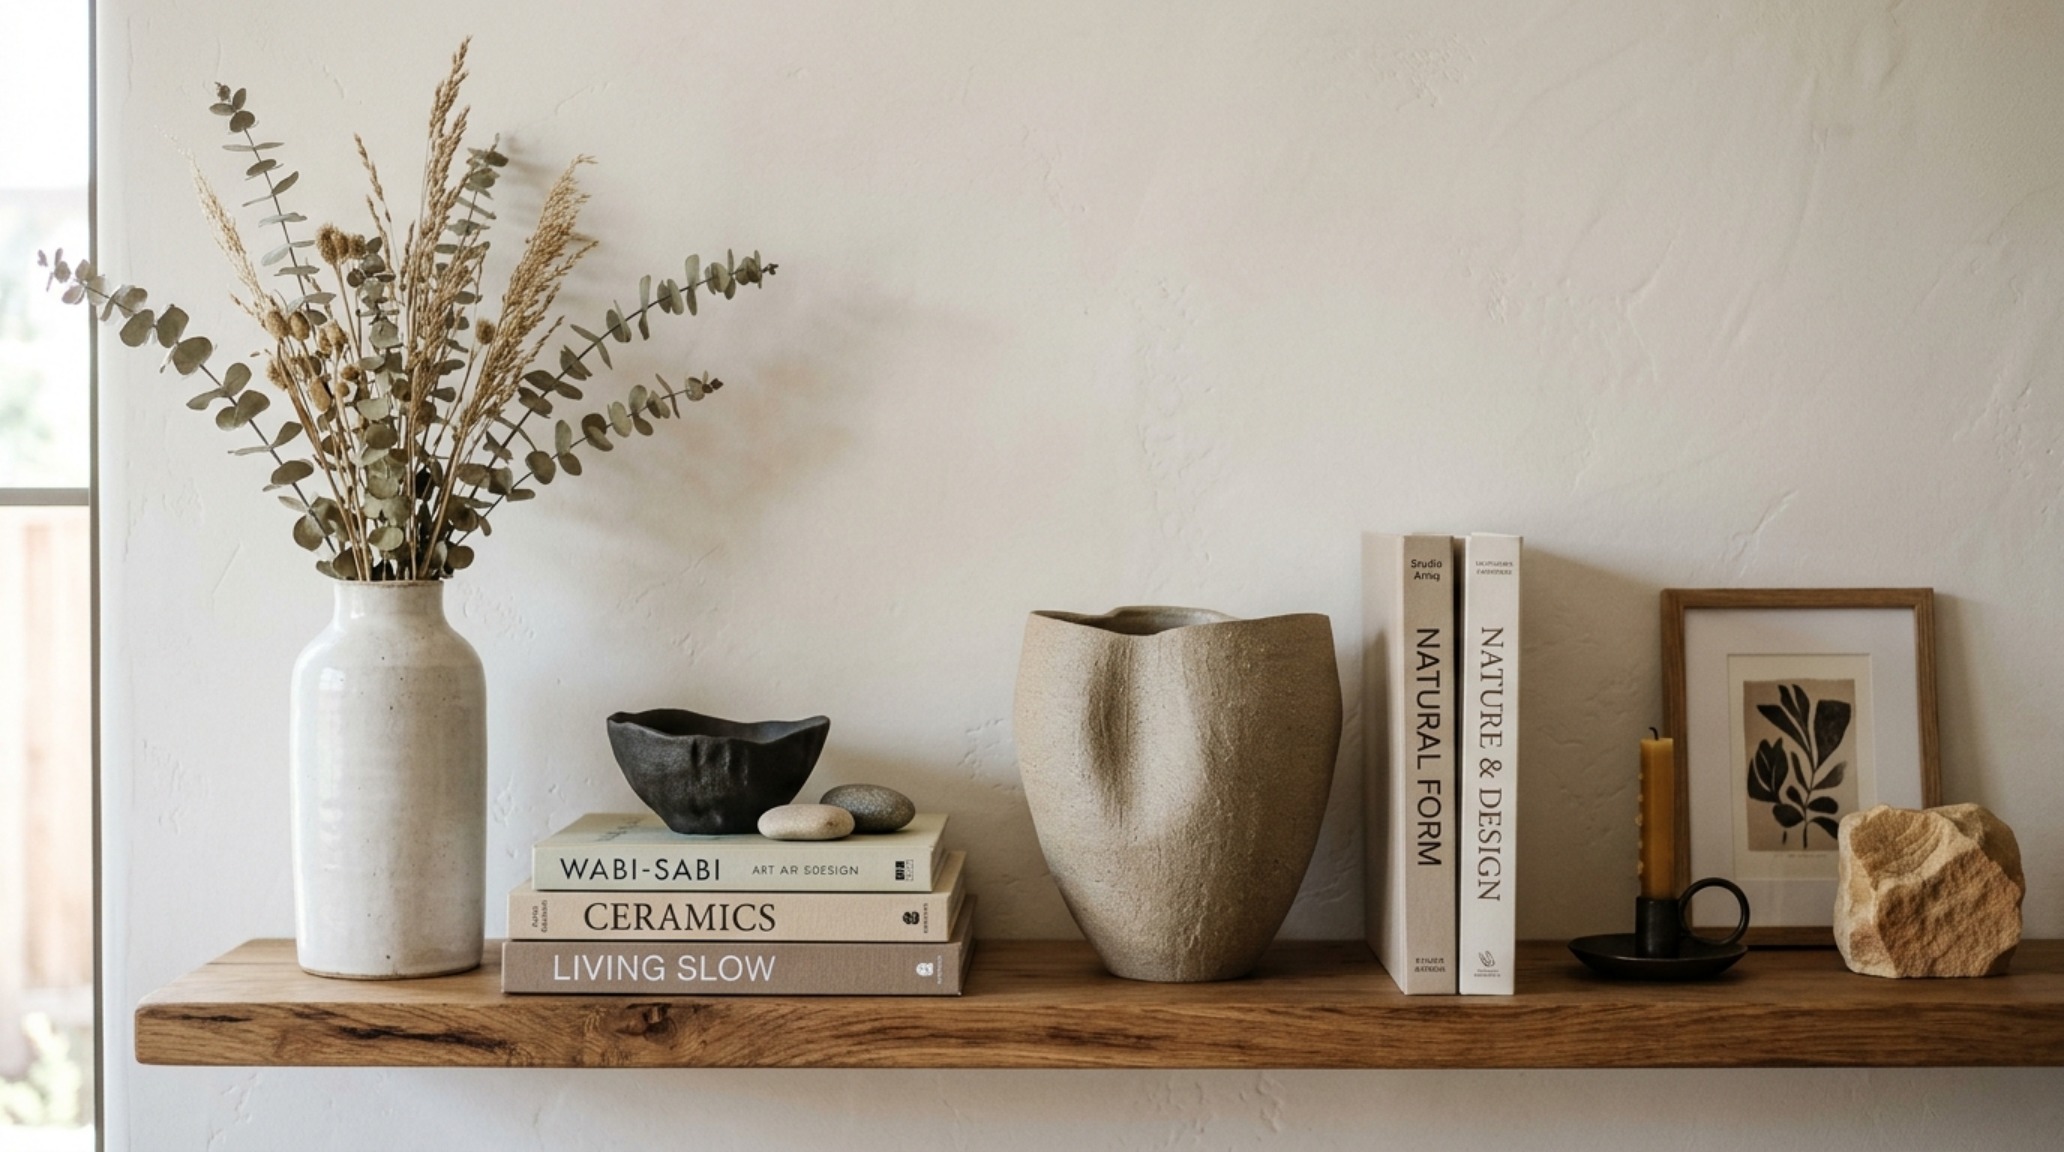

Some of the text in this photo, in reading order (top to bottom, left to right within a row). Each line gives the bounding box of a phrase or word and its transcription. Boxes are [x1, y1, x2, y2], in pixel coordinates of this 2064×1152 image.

[1416, 628, 1442, 866] NATURAL FORM
[1477, 626, 1504, 901] NATURE & DESIGN
[560, 858, 720, 881] WABI-SABI
[752, 865, 775, 875] ART
[584, 902, 776, 932] CERAMICS
[554, 954, 776, 982] LIVING SLOW
